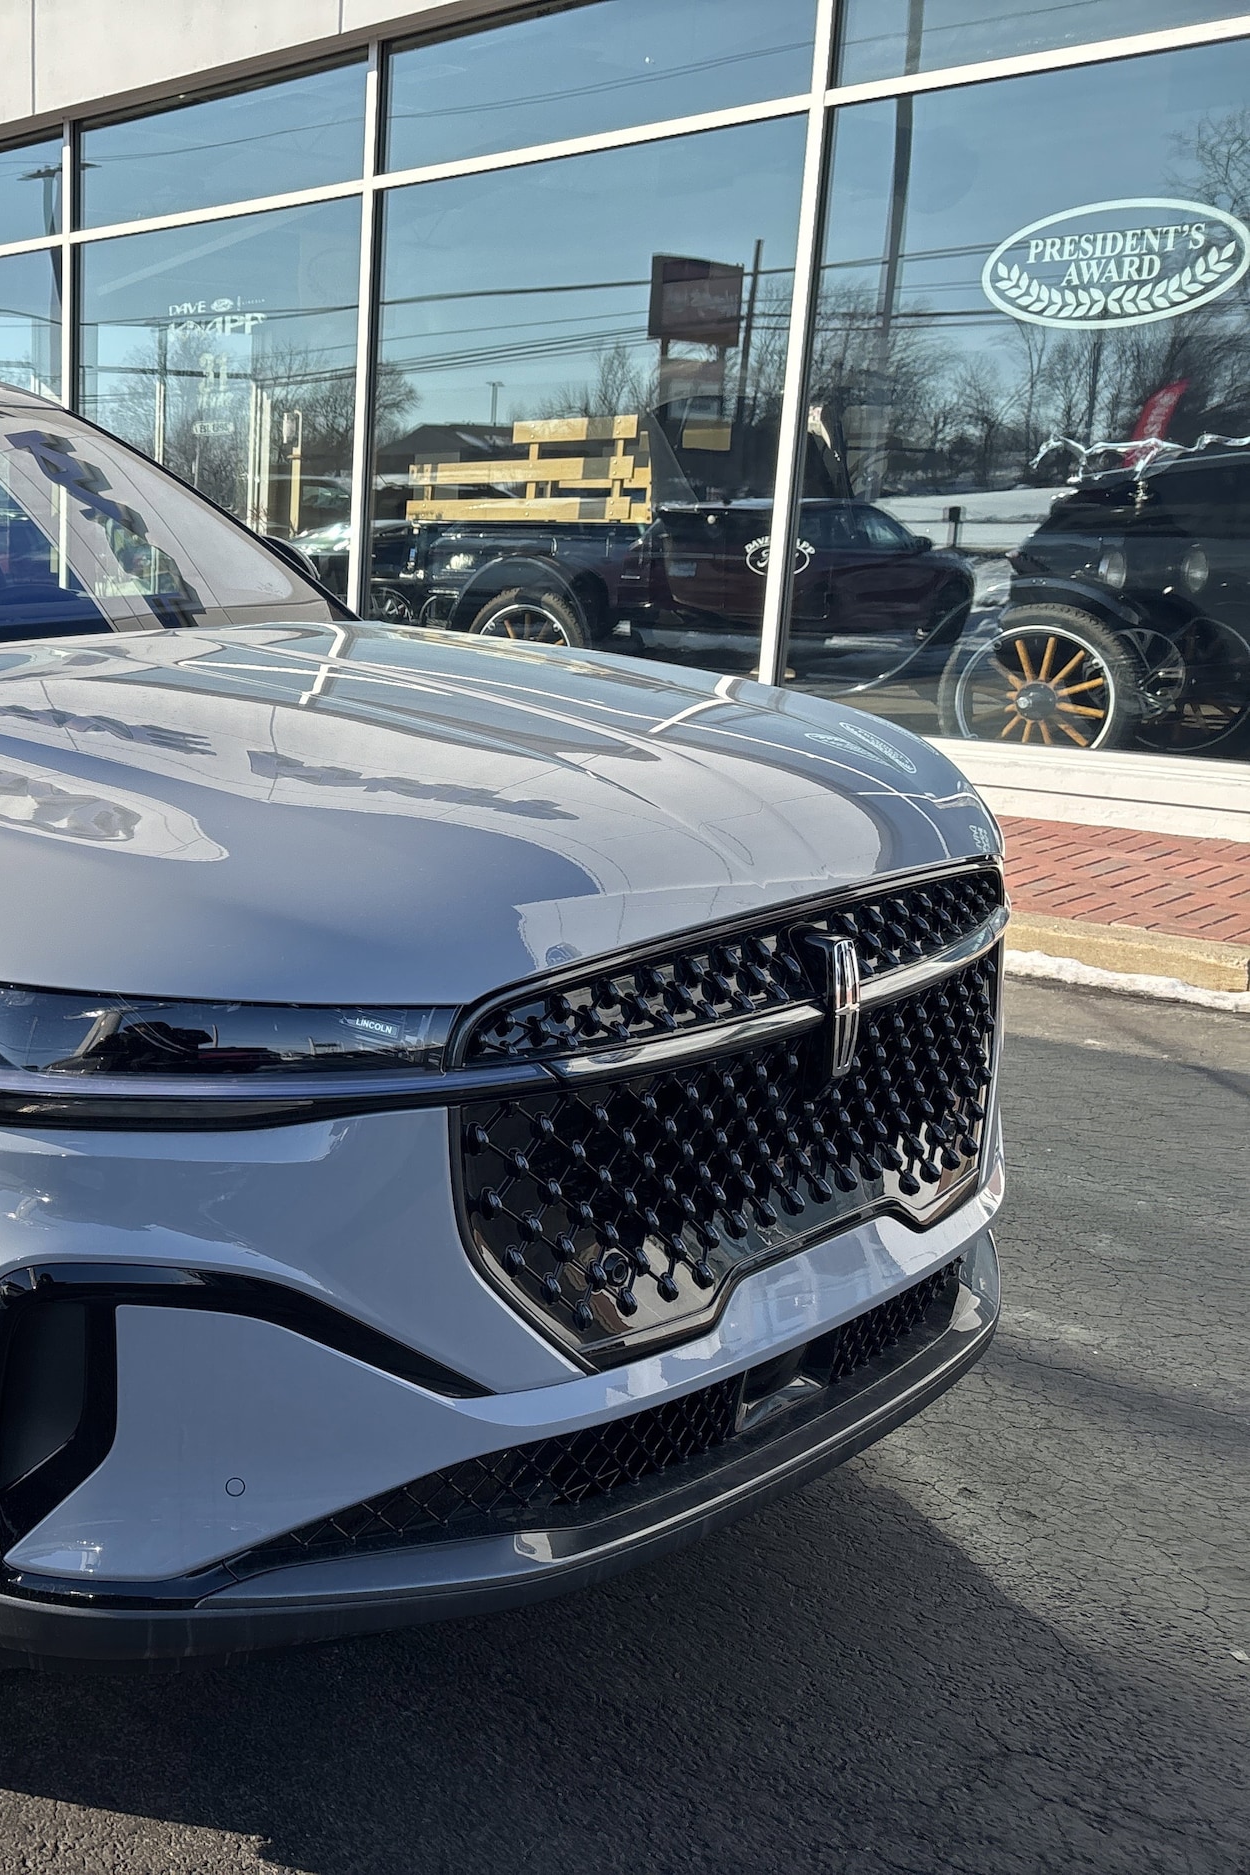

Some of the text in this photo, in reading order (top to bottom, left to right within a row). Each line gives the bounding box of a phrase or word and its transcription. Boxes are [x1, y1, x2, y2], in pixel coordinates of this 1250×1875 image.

[1026, 222, 1206, 264] PRESIDENT'S
[1060, 254, 1161, 287] AWARD
[168, 300, 207, 316] DAVE
[355, 1017, 393, 1034] LINCOLN
